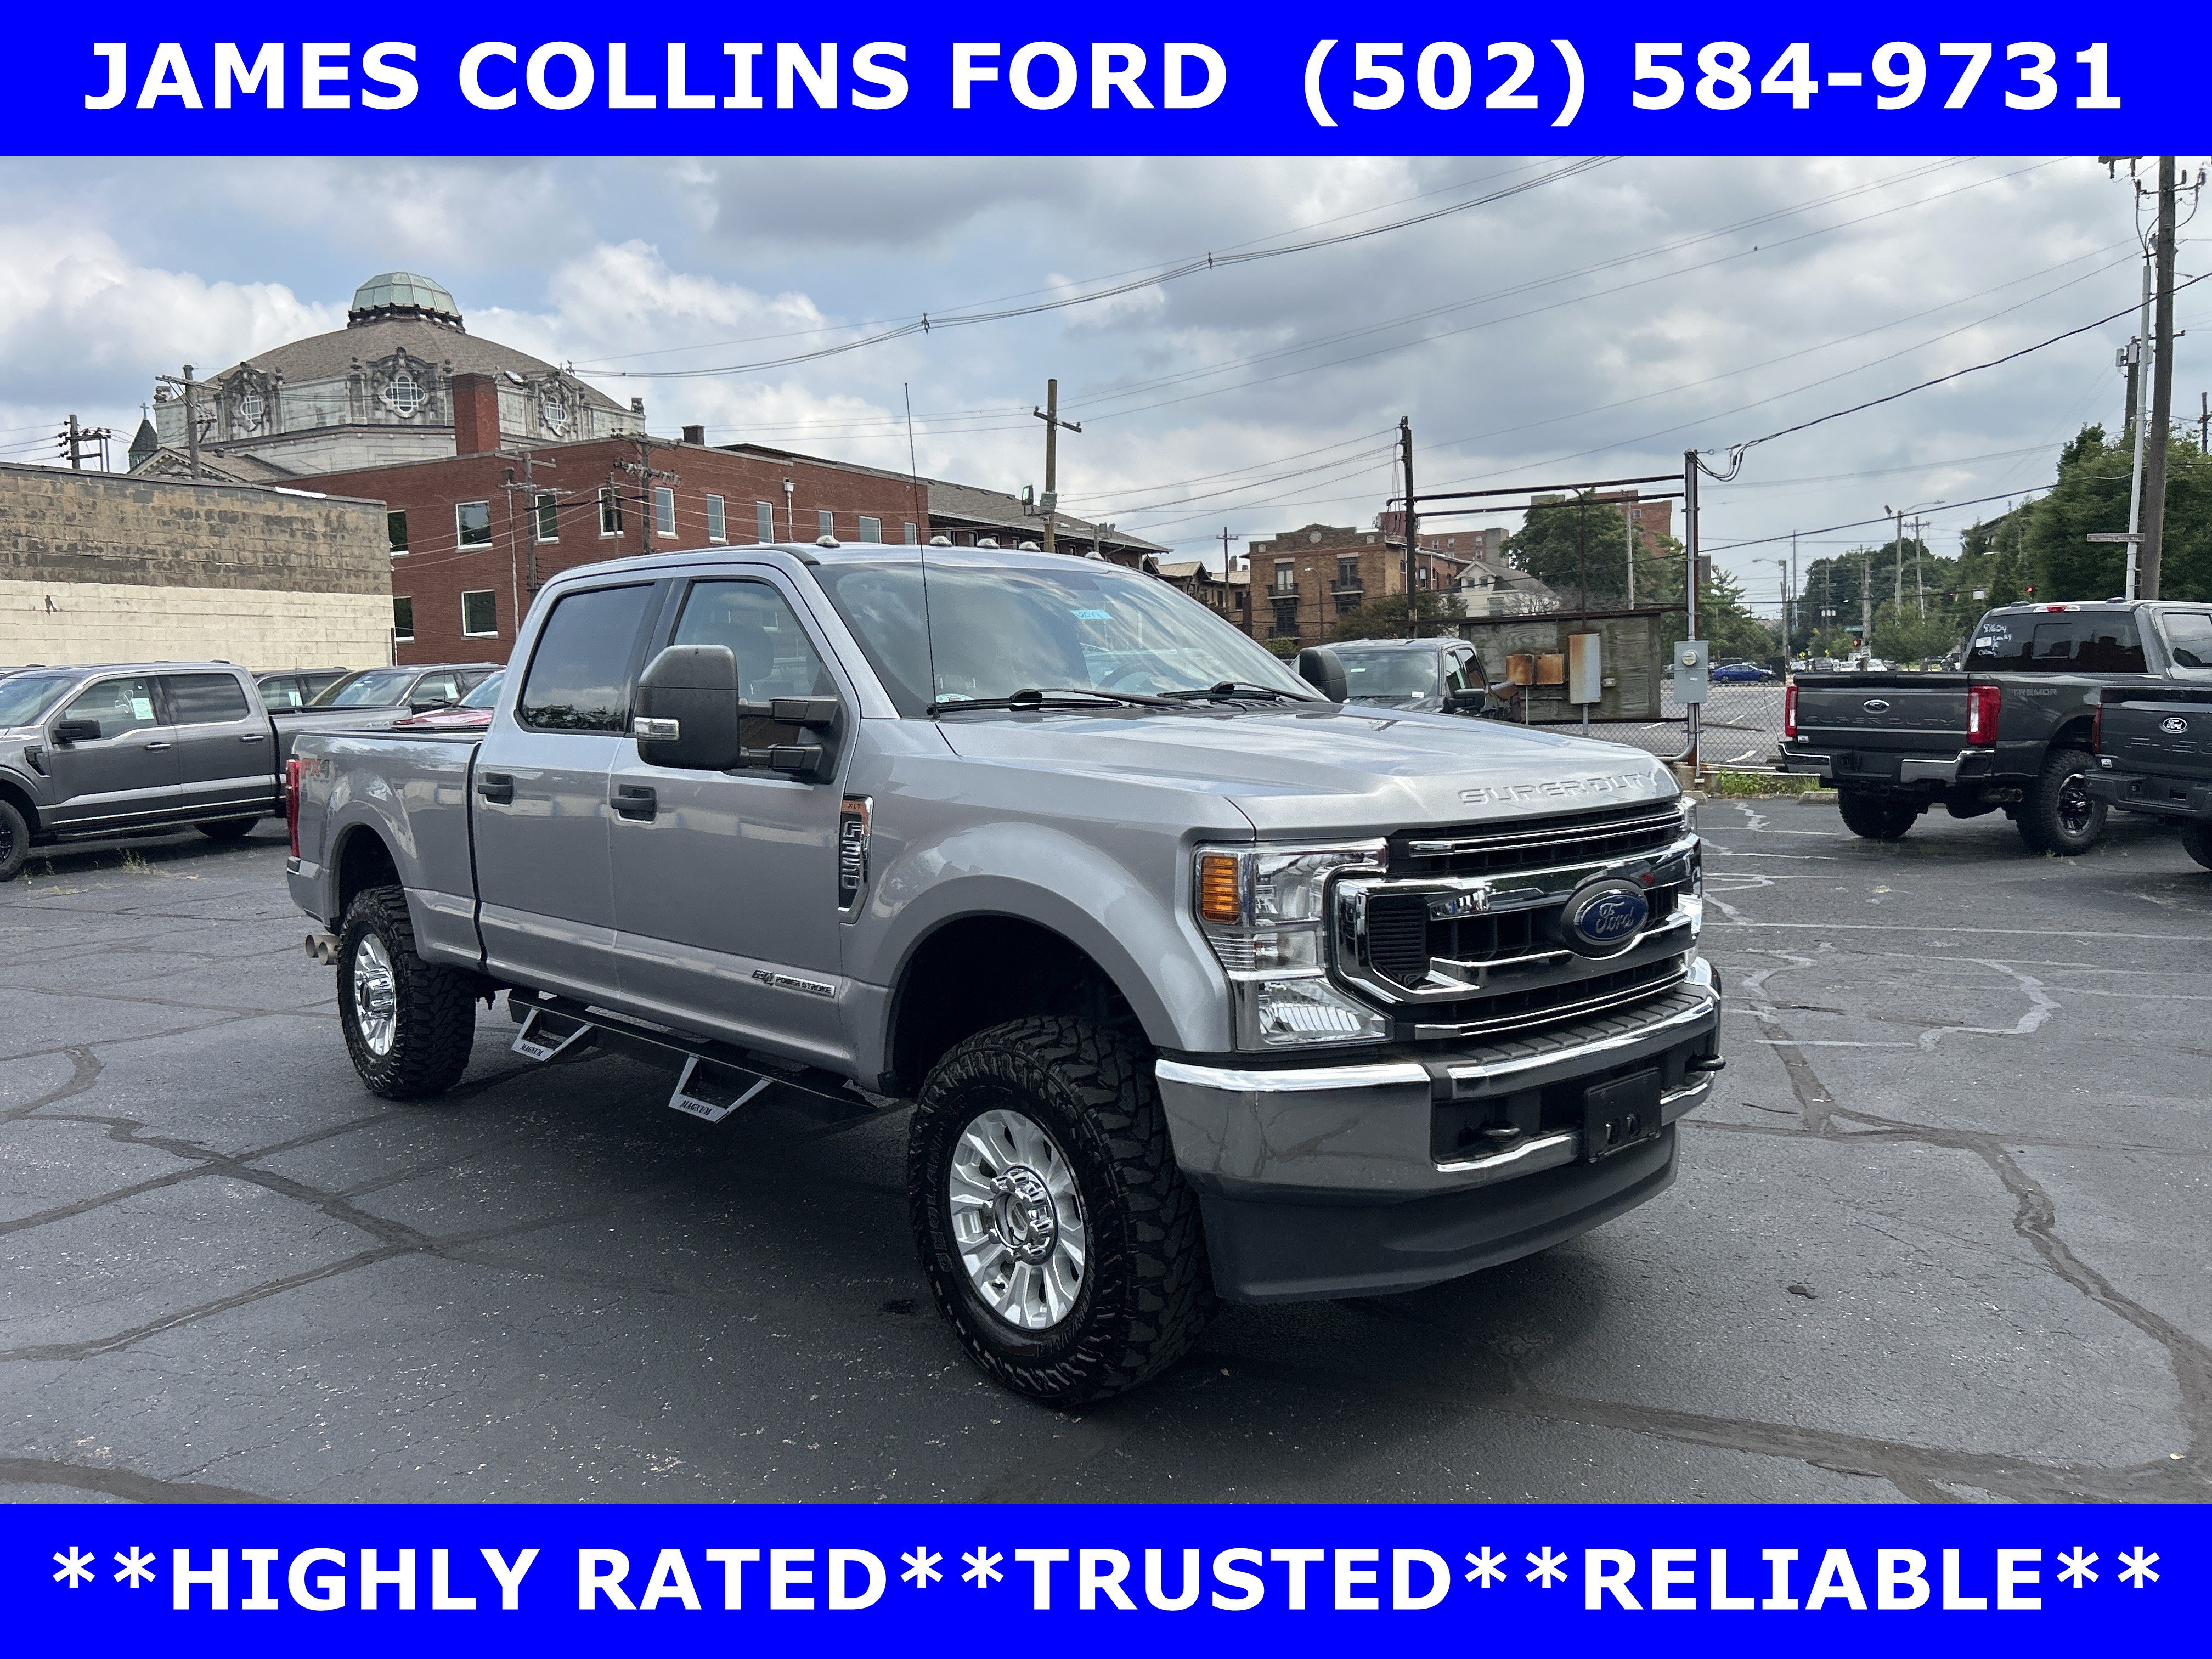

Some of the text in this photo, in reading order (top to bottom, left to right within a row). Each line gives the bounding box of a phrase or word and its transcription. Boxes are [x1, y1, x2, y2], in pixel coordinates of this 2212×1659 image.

[1805, 715, 1955, 726] SUPER DUTY
[300, 758, 330, 779] FX4
[1458, 772, 1658, 806] SUPER DUTY
[1595, 901, 1634, 933] Ford
[802, 981, 832, 994] STROKE
[520, 1043, 544, 1056] MAGNUM
[680, 1099, 713, 1115] MAGNUM
